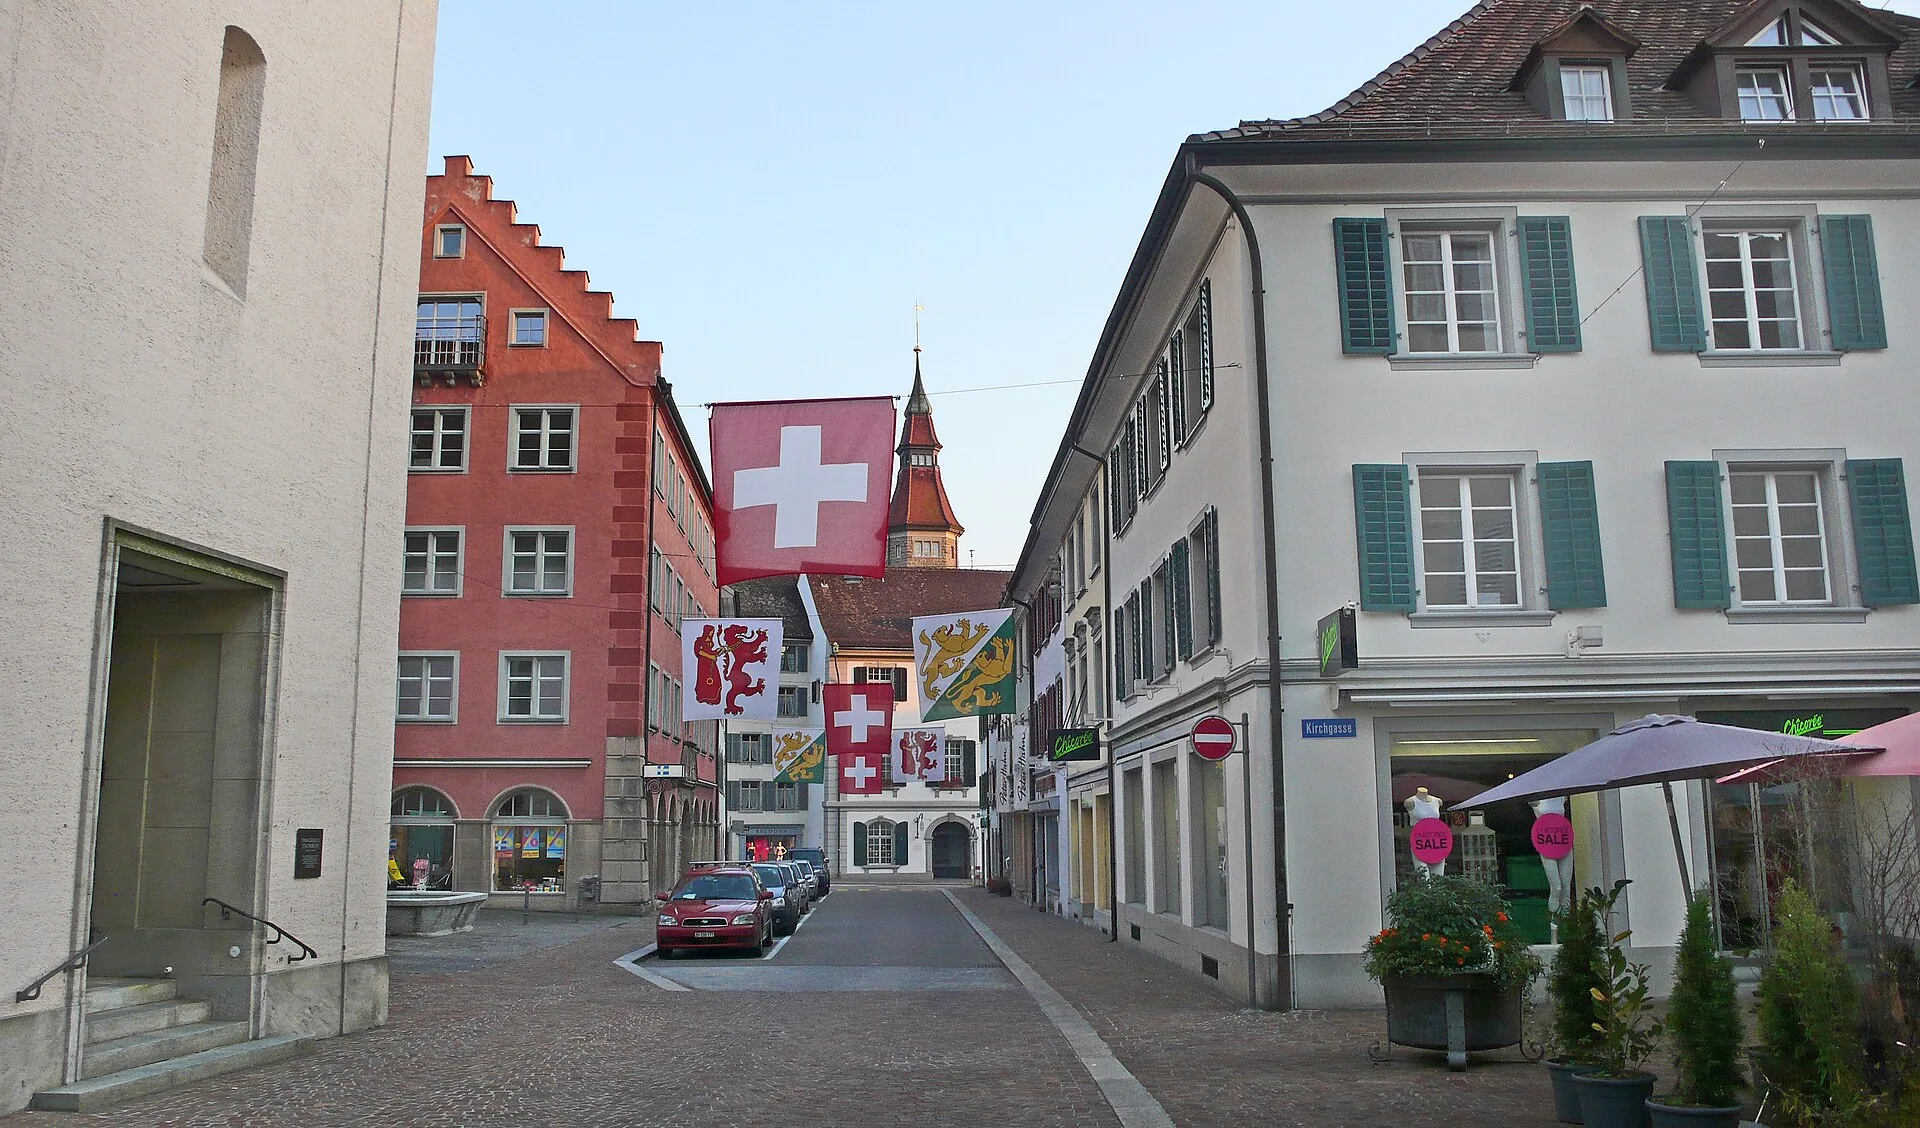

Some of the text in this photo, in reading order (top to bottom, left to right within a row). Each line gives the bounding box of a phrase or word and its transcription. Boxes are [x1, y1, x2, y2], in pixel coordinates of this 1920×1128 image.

[1306, 722, 1352, 736] Kirchgasse
[1416, 838, 1448, 850] SALE
[1537, 833, 1569, 845] SALE
